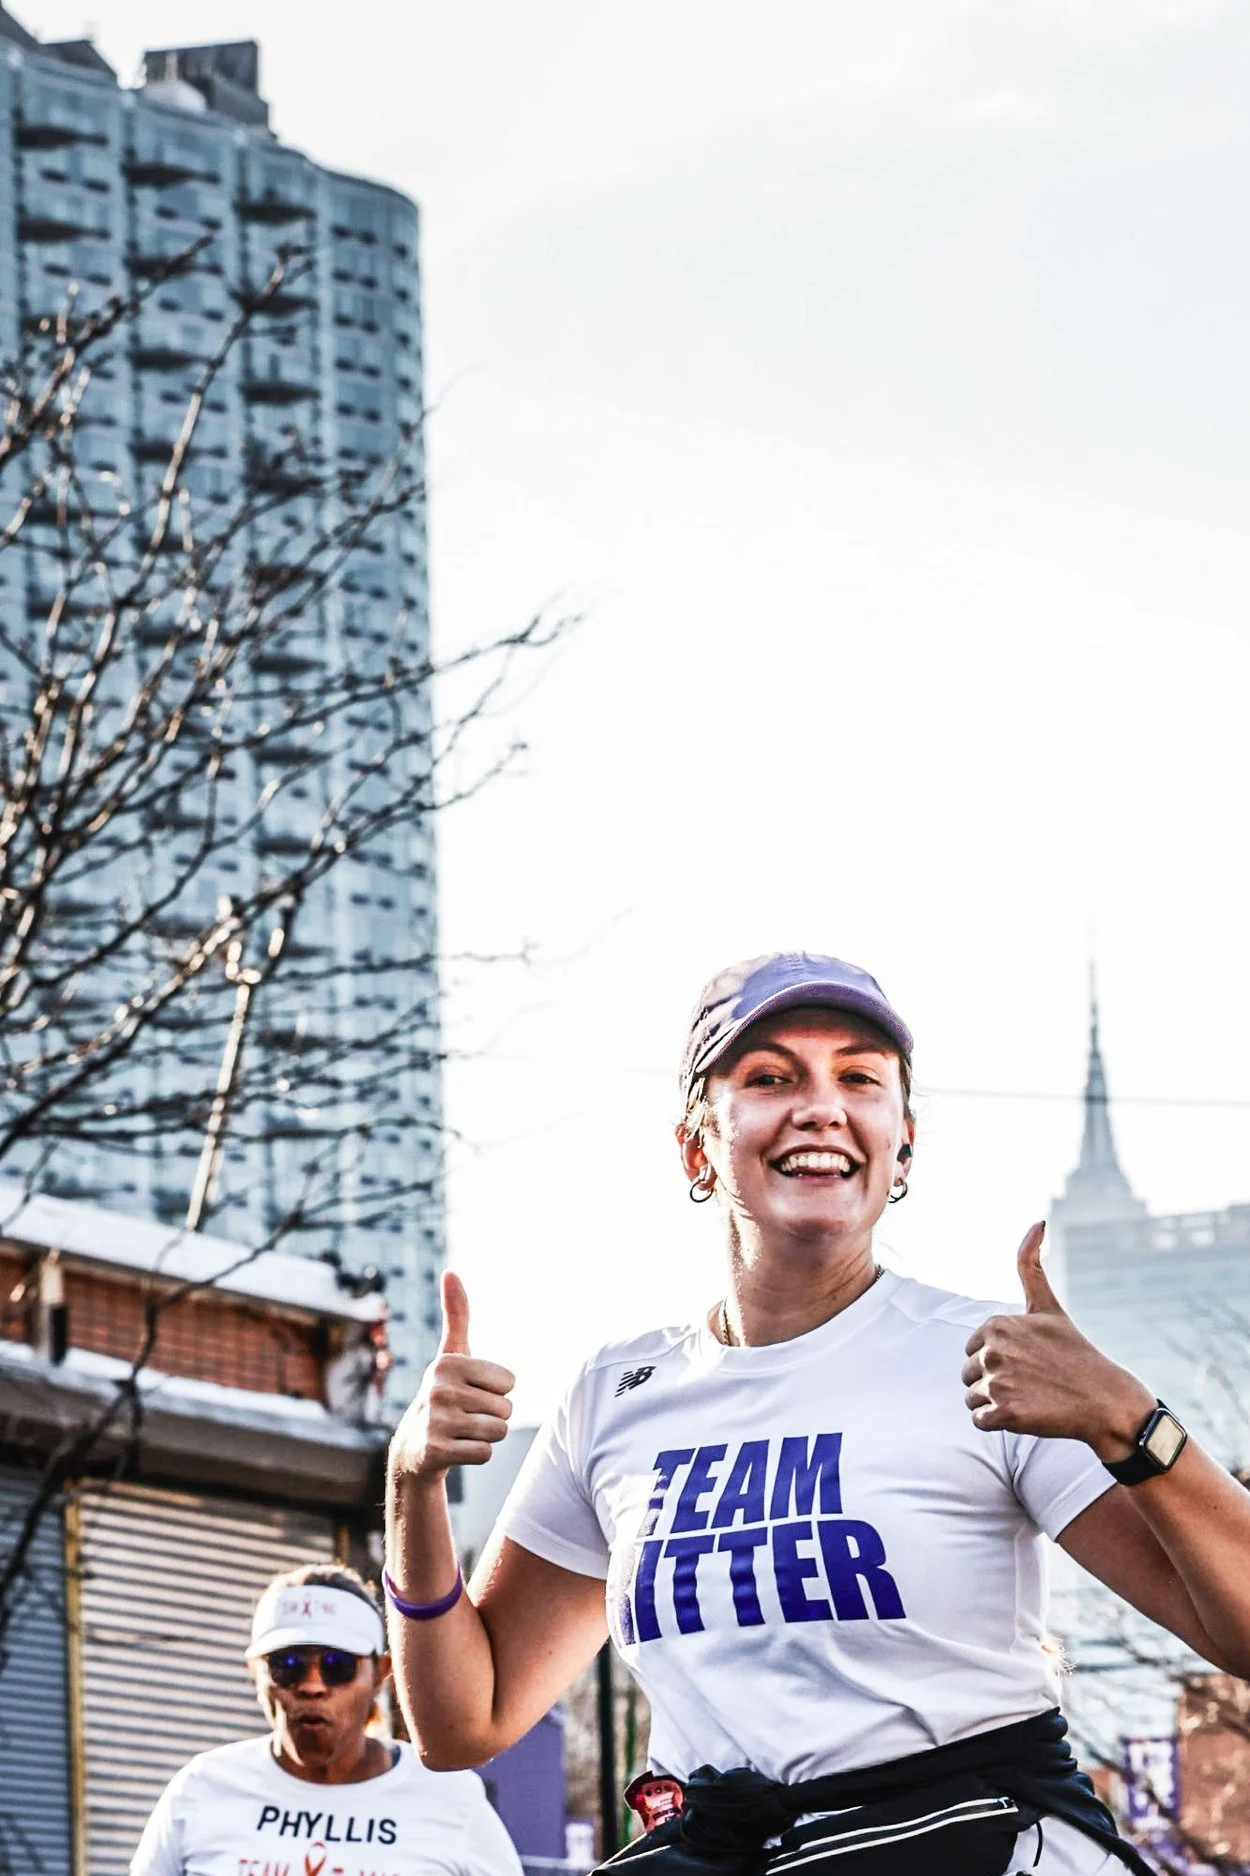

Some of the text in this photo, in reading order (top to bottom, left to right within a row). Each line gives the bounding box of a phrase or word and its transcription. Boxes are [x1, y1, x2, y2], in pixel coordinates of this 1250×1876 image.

[638, 1432, 843, 1536] TEAM
[618, 1520, 907, 1646] ITTER
[257, 1805, 398, 1845] PHYLLIS
